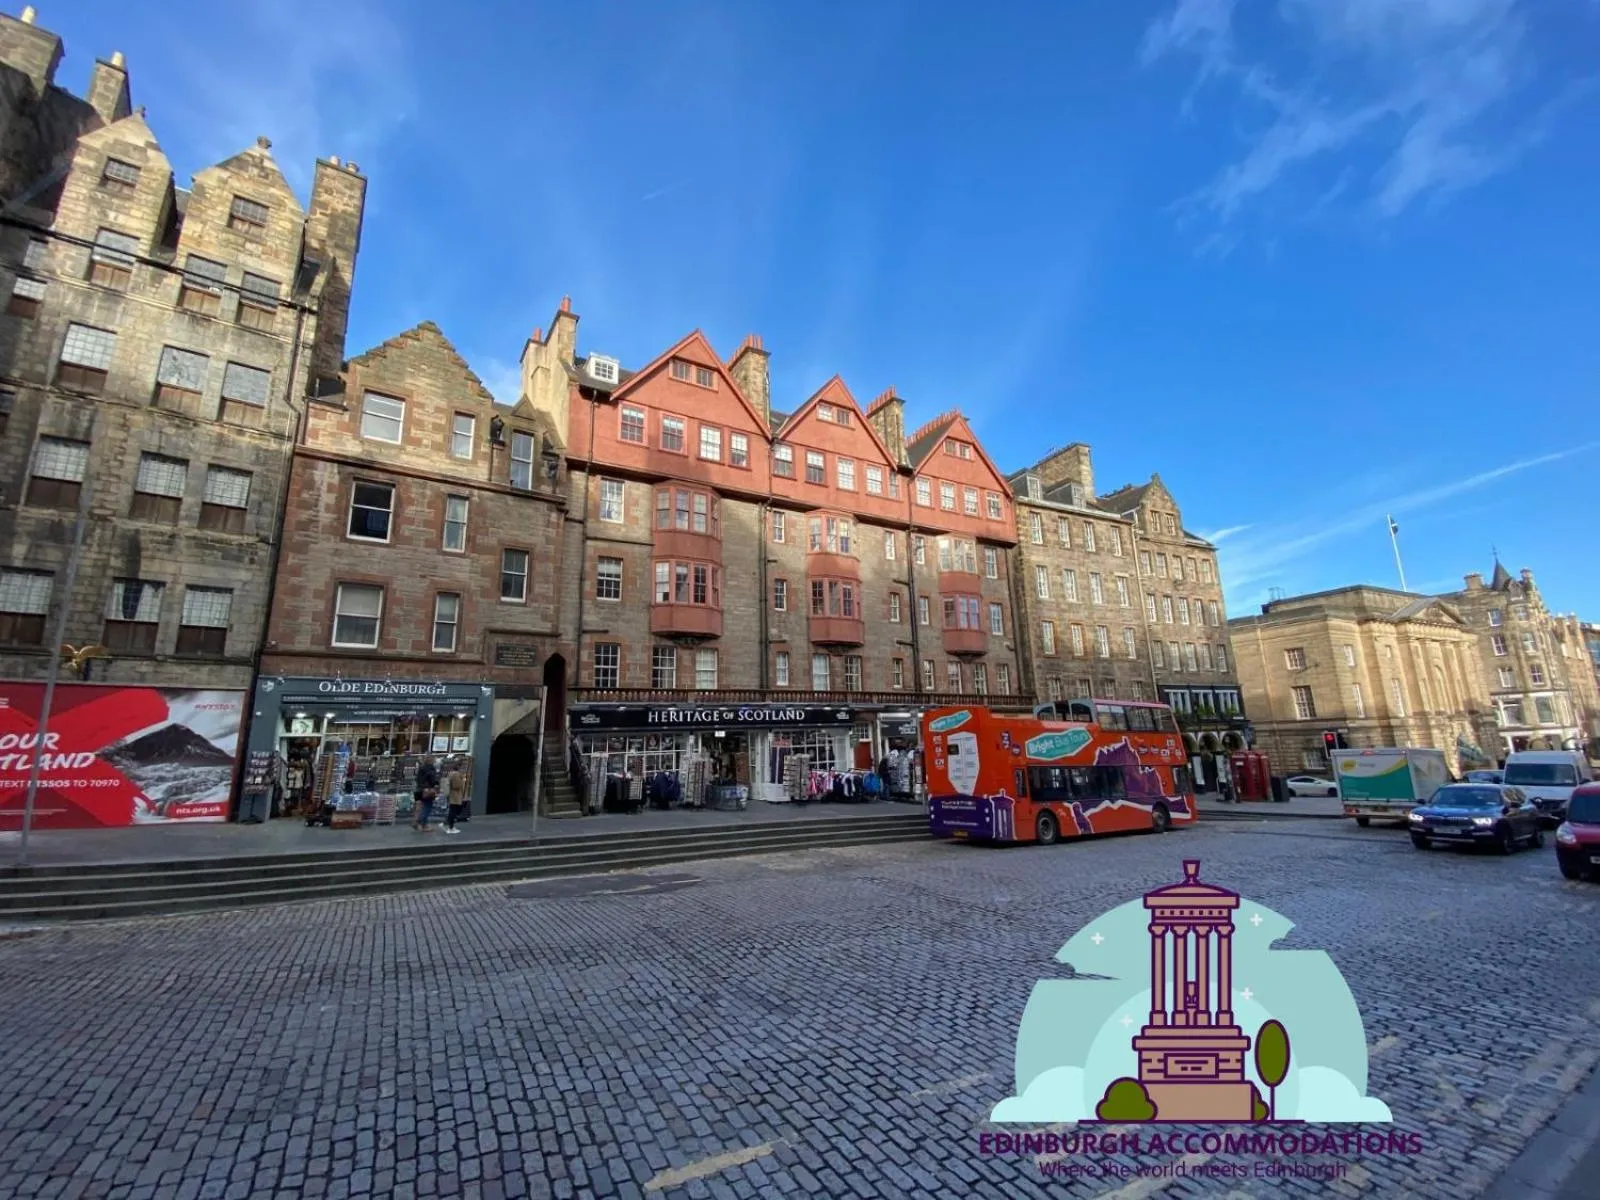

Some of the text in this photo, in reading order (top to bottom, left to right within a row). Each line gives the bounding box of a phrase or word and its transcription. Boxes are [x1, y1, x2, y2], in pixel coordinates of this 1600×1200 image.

[319, 681, 446, 695] OLDE EDINBURGH
[648, 709, 805, 722] HERITAGE OF SCOTLAND
[1028, 740, 1054, 754] Bright
[1054, 736, 1069, 747] Bus
[0, 780, 24, 788] TEXT
[73, 779, 87, 788] TO
